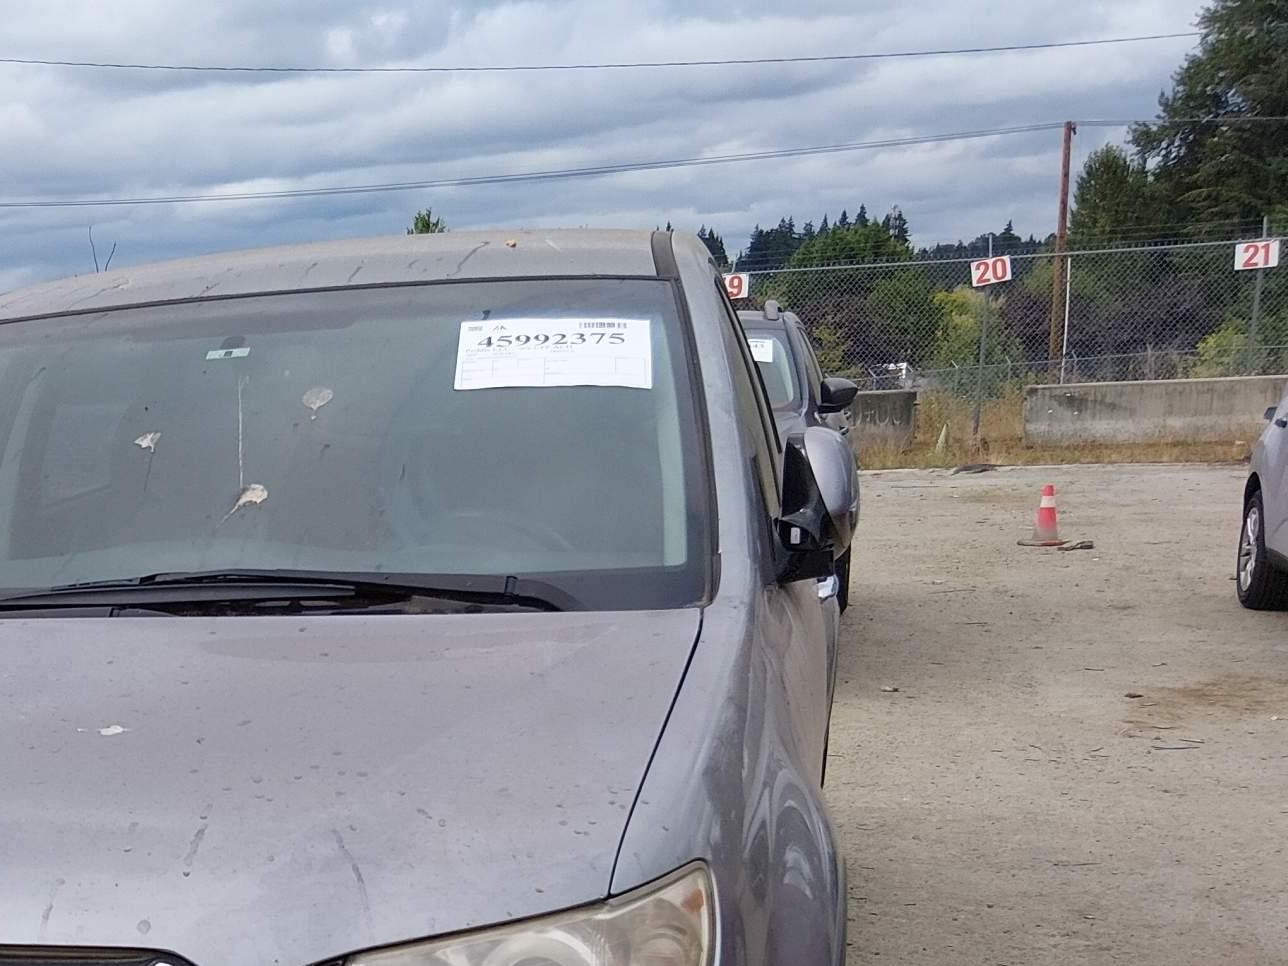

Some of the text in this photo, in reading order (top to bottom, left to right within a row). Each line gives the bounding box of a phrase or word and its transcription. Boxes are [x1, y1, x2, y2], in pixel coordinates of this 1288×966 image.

[1242, 243, 1270, 268] 21
[974, 258, 1007, 284] 20
[723, 275, 743, 298] 9
[477, 332, 626, 348] 45992375
